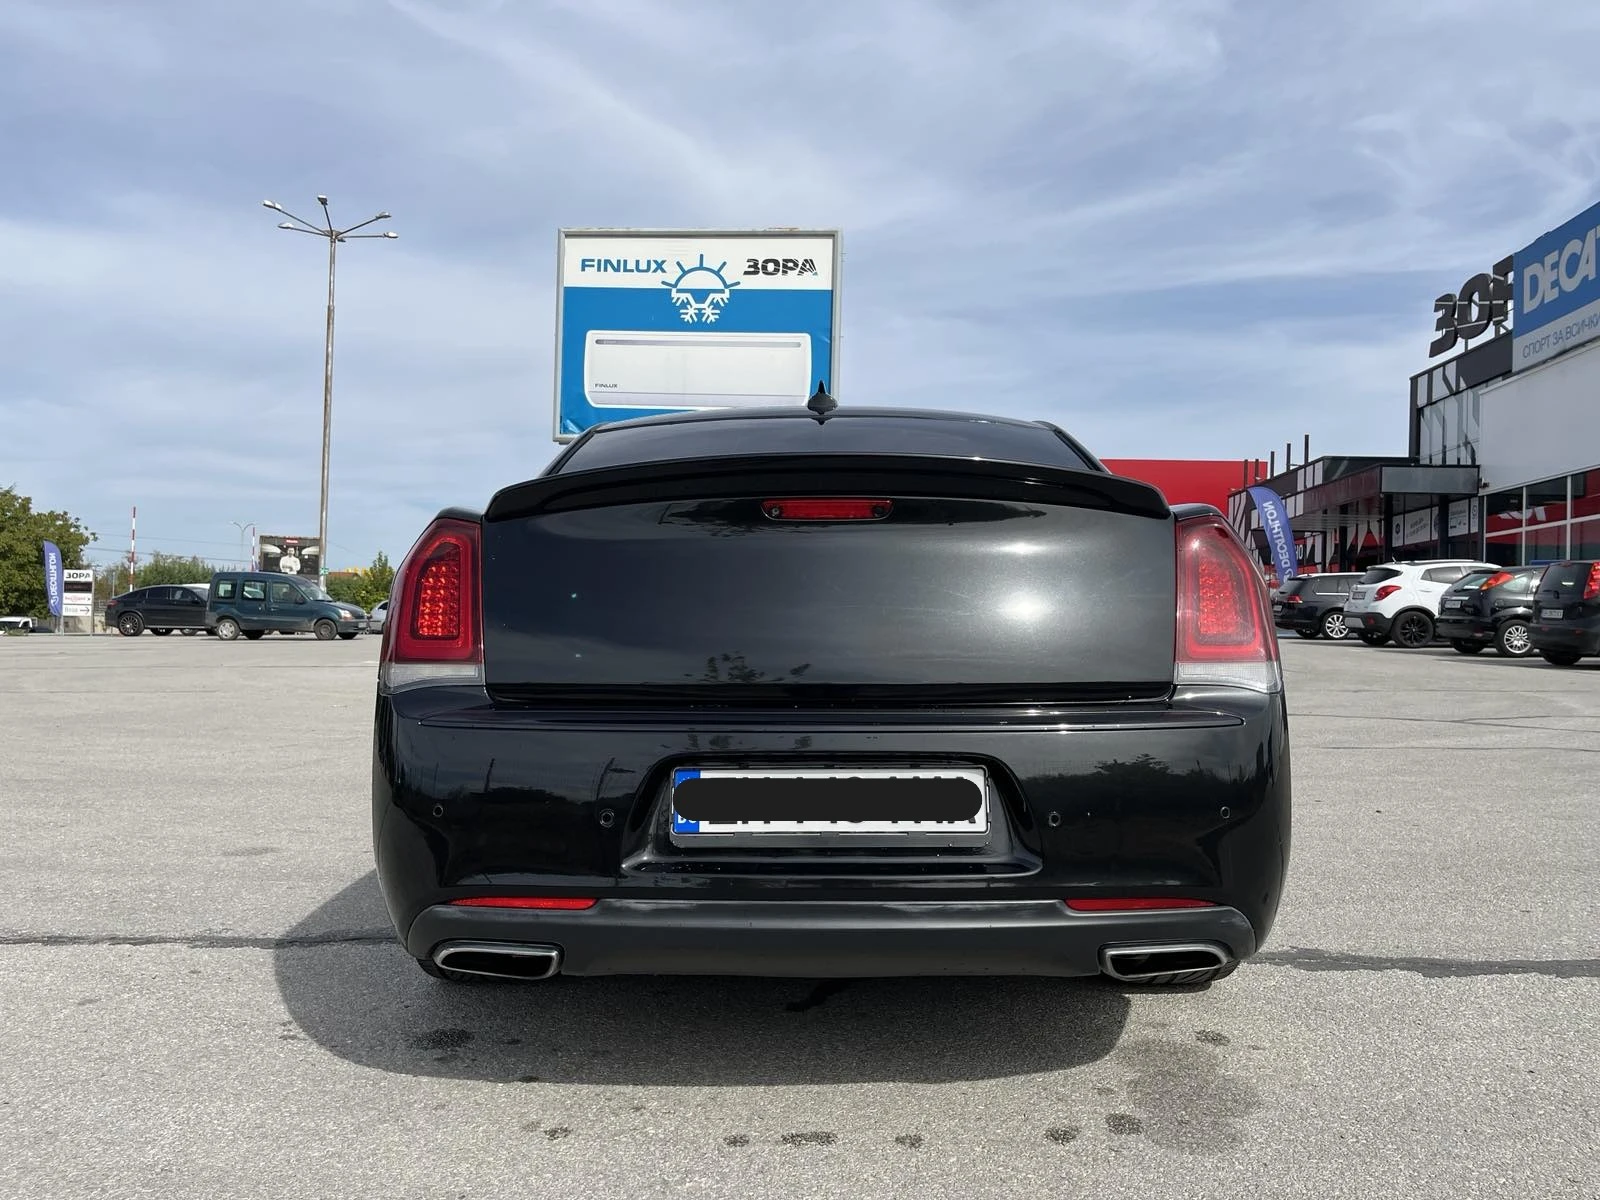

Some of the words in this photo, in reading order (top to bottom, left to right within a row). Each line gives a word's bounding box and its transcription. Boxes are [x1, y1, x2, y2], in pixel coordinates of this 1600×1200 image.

[580, 258, 668, 273] FINLUX
[743, 257, 818, 276] ЗОРА
[1522, 334, 1551, 359] СПОРТ
[1552, 329, 1564, 346] ЗА
